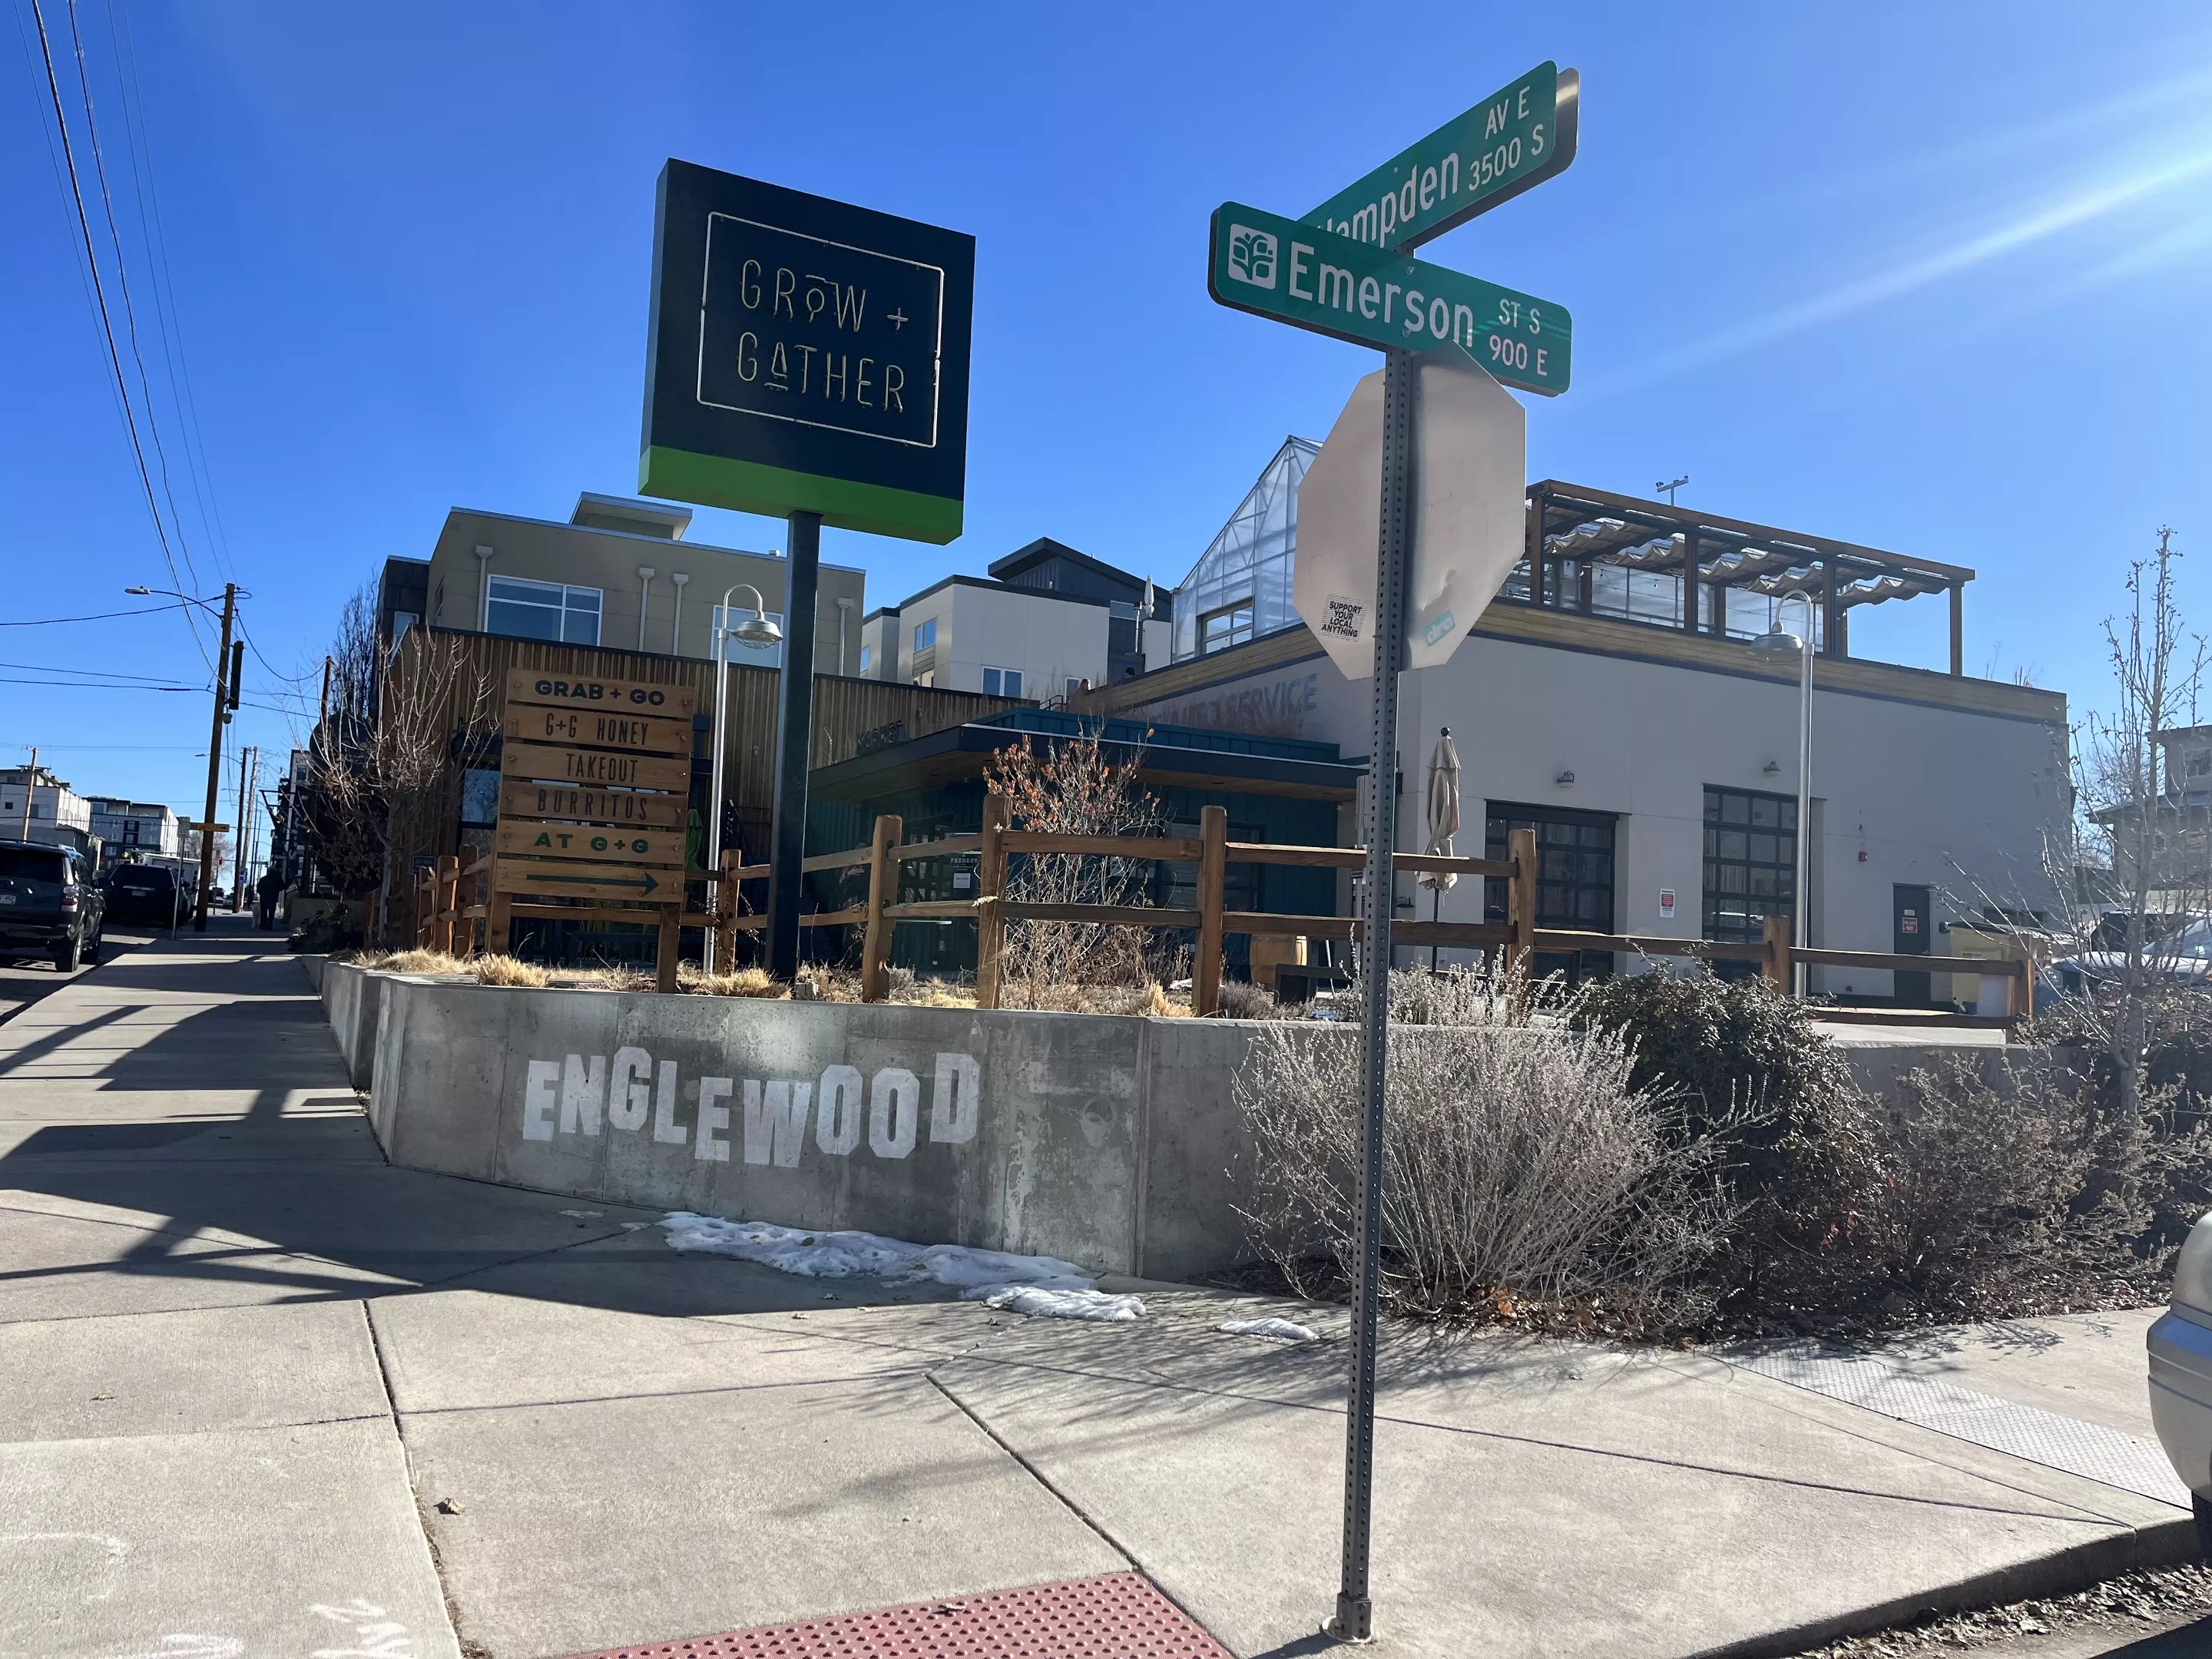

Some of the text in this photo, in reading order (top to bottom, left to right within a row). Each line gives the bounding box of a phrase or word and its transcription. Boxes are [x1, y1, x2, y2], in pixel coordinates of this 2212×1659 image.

[1485, 85, 1530, 140] AV E
[1468, 137, 1521, 191] 3500
[1531, 124, 1545, 155] S
[740, 259, 866, 333] GROW
[1289, 240, 1474, 347] Emerson
[1498, 298, 1541, 335] ST S
[737, 331, 905, 413] GATHER
[1488, 334, 1548, 376] 900 E
[1329, 601, 1363, 614] SUPPORT
[1330, 618, 1353, 628] LOCAL
[1333, 610, 1354, 621] YOUR
[1321, 623, 1358, 637] ANYTHING
[535, 680, 604, 700] GRAB
[629, 689, 665, 706] GO
[1227, 673, 1317, 725] SERVICE
[545, 712, 649, 745] G+G HONEY
[566, 753, 639, 783] TAKEOUT
[538, 788, 647, 820] BURRITOS
[534, 832, 649, 854] AT G+G
[522, 1046, 981, 1168] ENGLEWOOD
